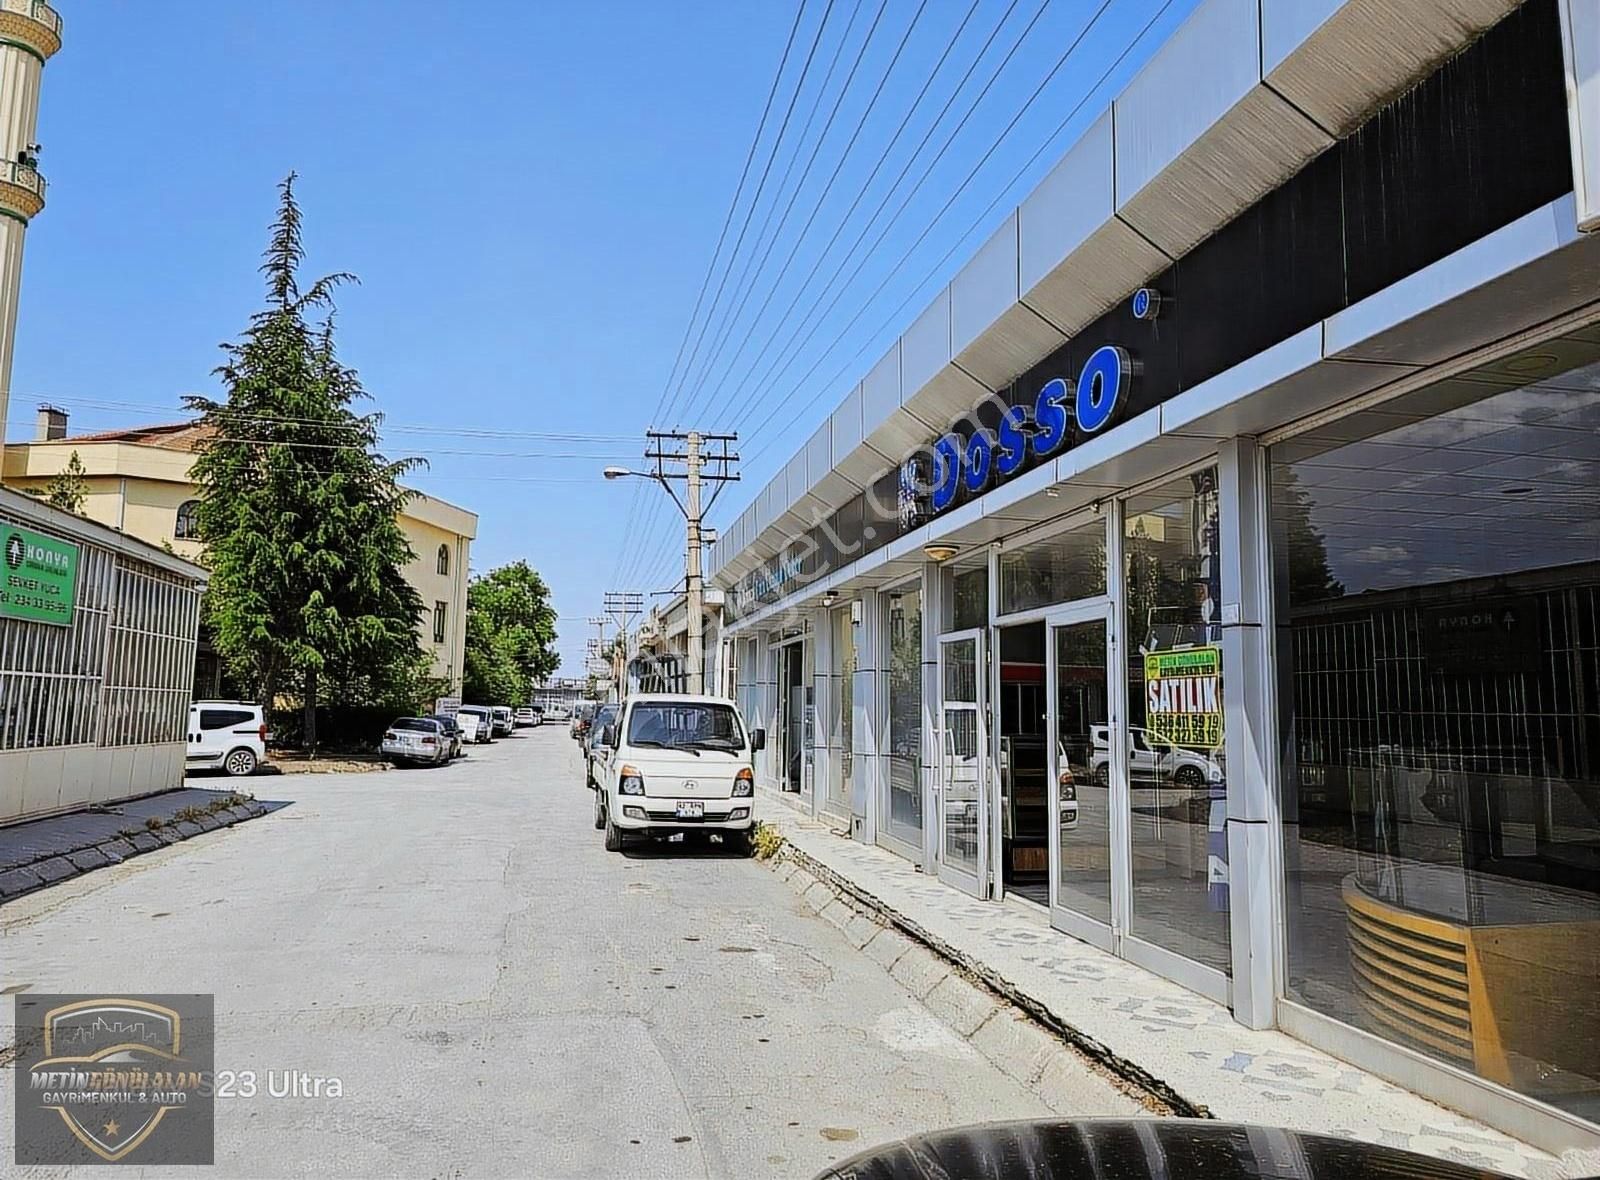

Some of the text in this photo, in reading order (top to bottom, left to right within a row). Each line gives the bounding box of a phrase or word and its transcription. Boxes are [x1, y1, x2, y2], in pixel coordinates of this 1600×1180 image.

[27, 544, 69, 569] KONYA
[1148, 678, 1218, 713] SATILIK
[1191, 714, 1205, 728] 59
[1206, 714, 1219, 728] 19
[1191, 728, 1205, 742] 59
[1206, 728, 1218, 743] 19
